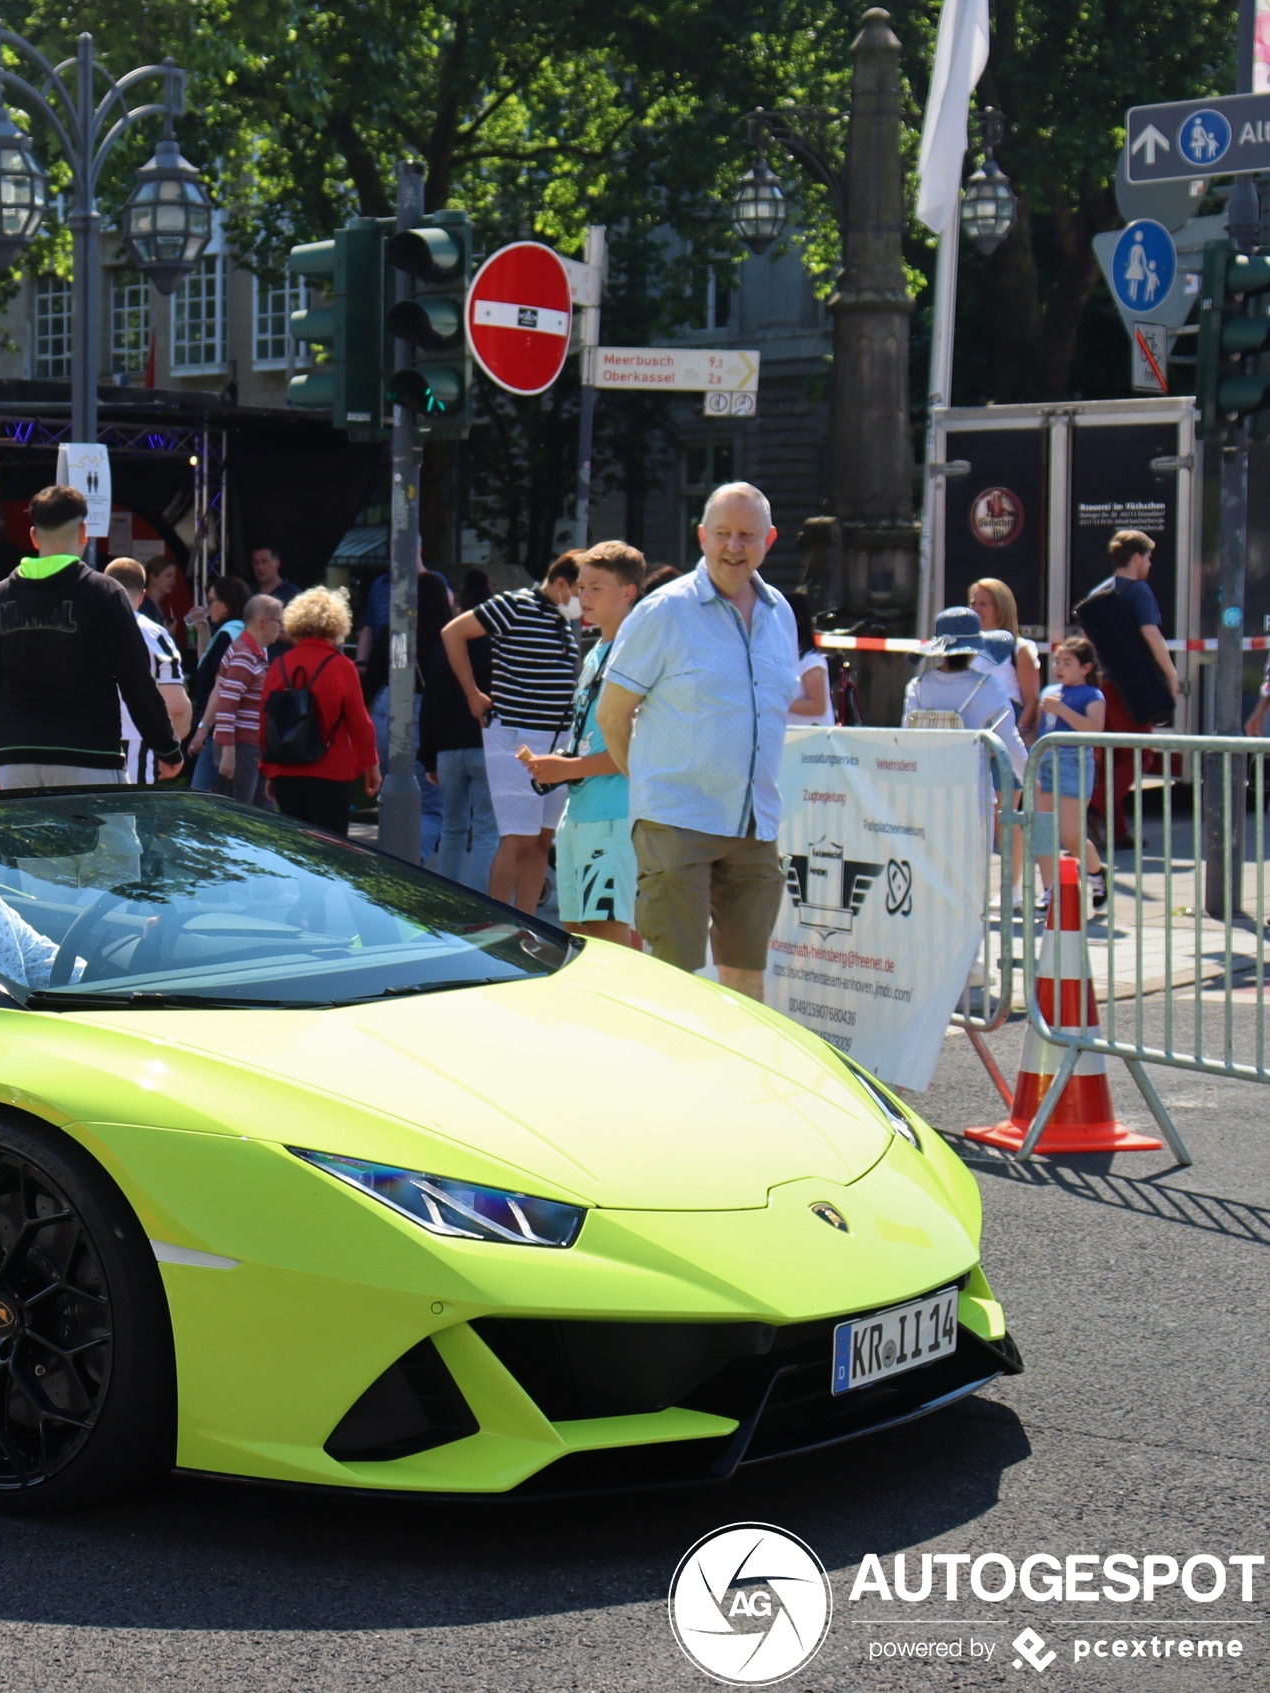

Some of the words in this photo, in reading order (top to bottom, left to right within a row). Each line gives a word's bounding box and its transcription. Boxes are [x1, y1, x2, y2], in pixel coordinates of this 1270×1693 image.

[603, 353, 675, 367] Meerbusch
[603, 370, 676, 383] Oberkassel
[1080, 503, 1111, 511] Brauerei
[1126, 501, 1166, 511] Füchschen
[875, 758, 918, 772] Verkehrsdienst
[803, 789, 847, 806] Zugbegleitung
[864, 819, 926, 840] Parkplatzeinweisung
[789, 998, 857, 1027] 0049/15907680436
[838, 1366, 846, 1380] D
[852, 1323, 883, 1380] KR
